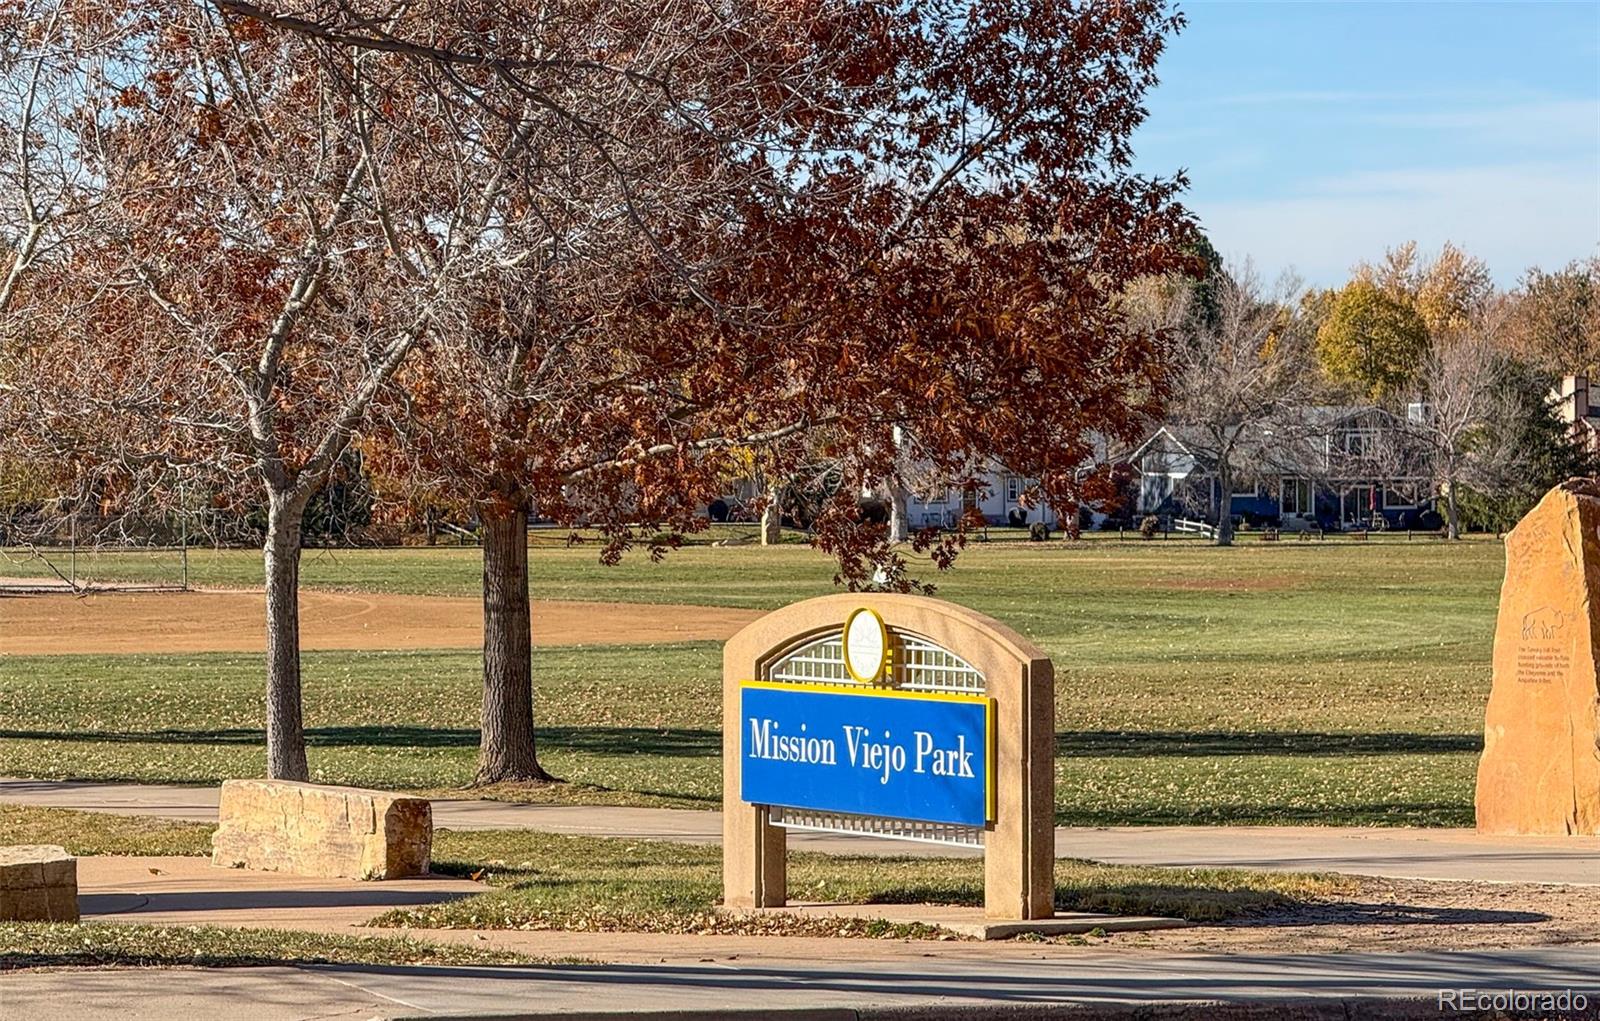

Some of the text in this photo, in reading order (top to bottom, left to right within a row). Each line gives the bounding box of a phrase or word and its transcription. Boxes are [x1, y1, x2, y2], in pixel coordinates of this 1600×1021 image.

[749, 718, 975, 785] Mission Viejo Park
